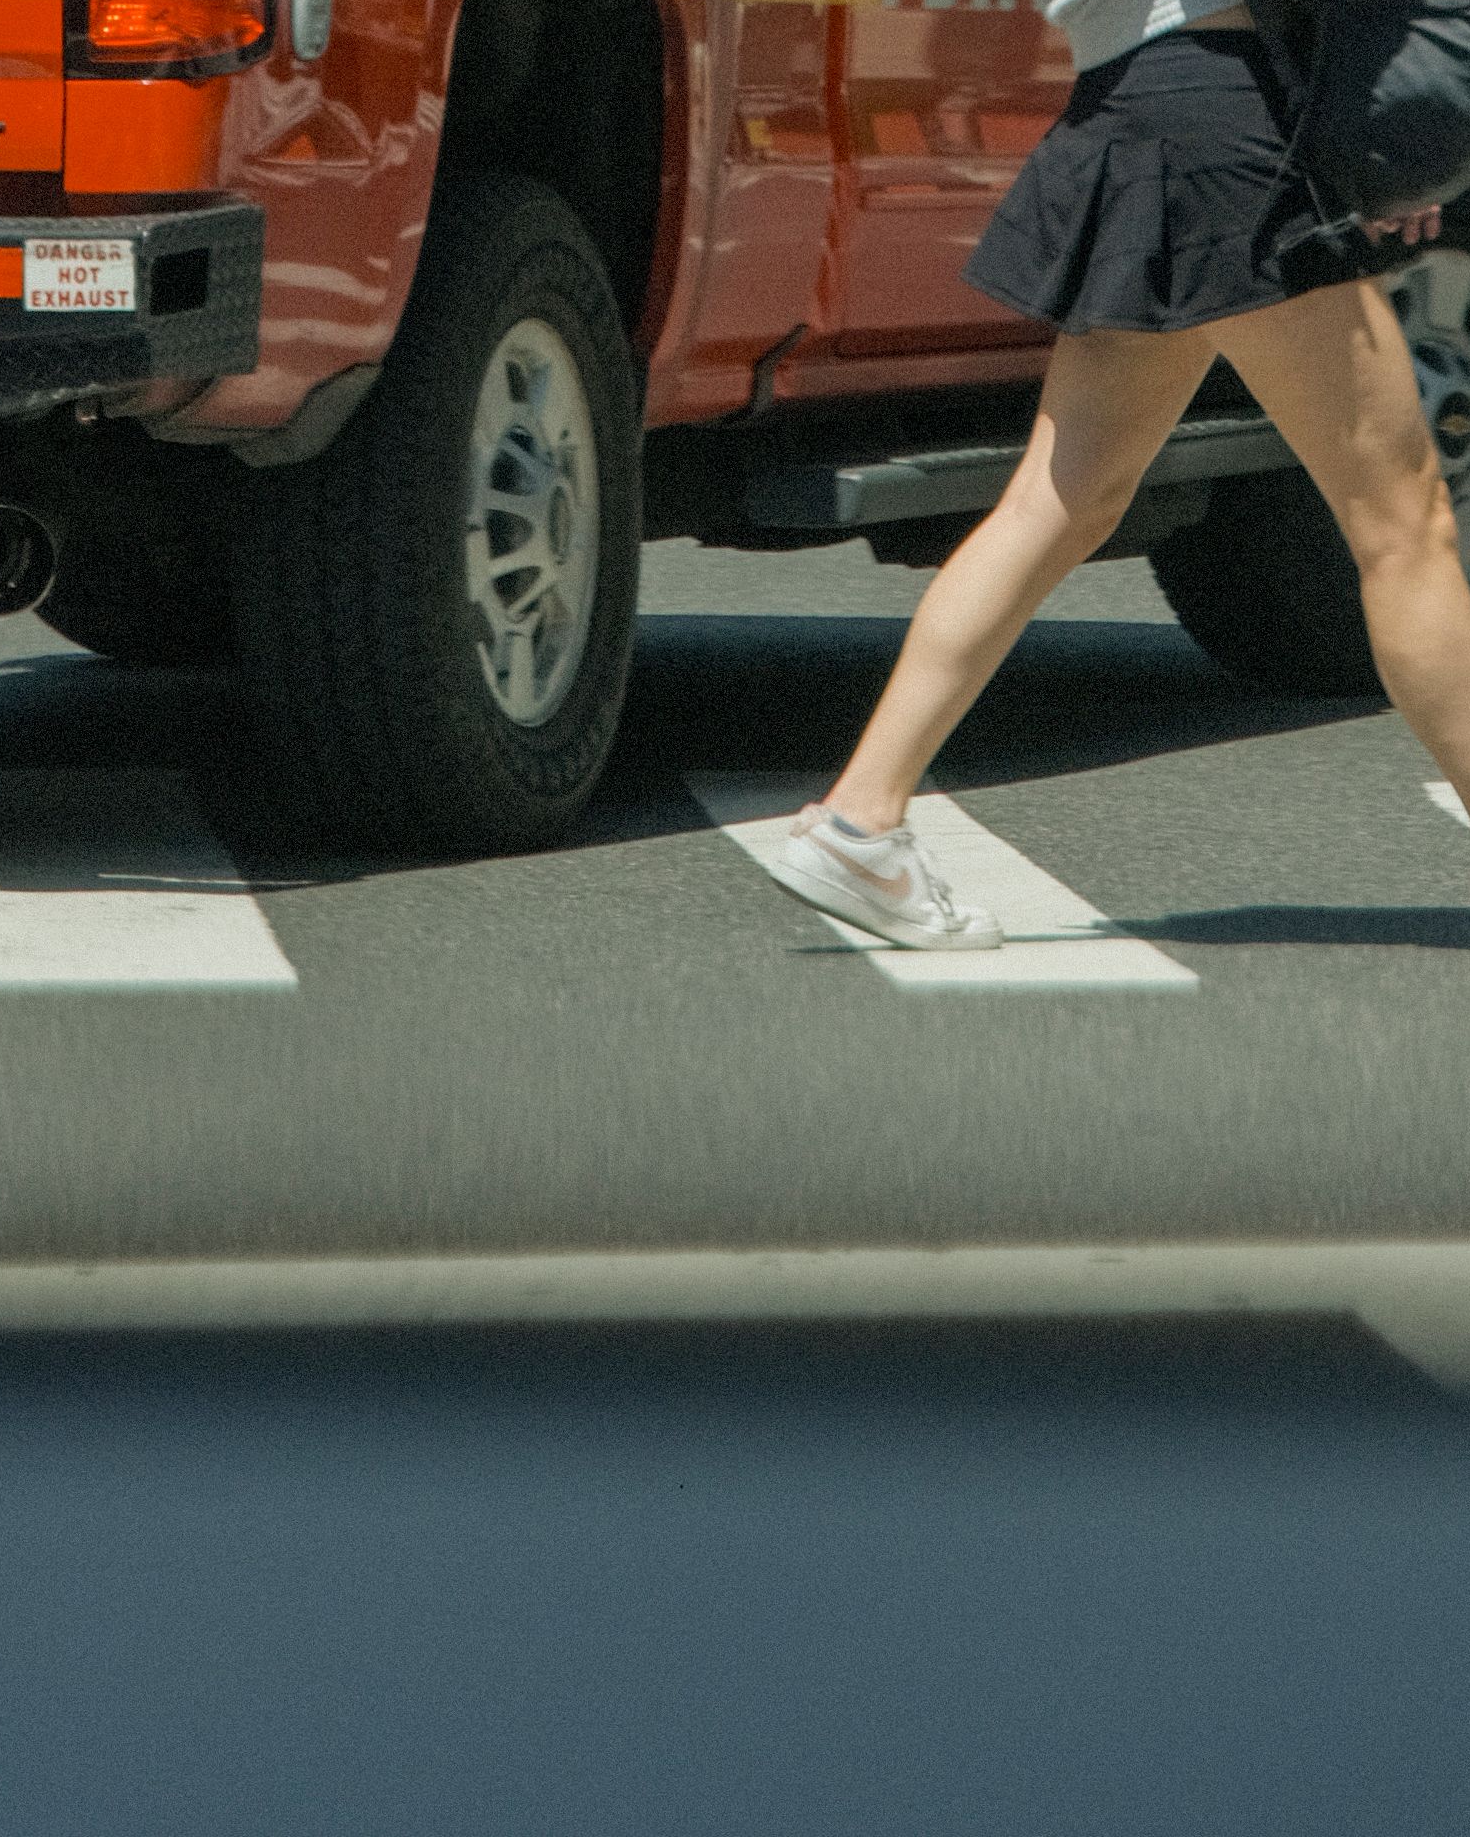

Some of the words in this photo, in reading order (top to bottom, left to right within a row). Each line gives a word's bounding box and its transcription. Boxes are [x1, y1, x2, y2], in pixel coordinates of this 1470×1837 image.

[34, 243, 122, 260] DANGER
[58, 266, 101, 283] HOT
[31, 290, 129, 307] EXHAUST
